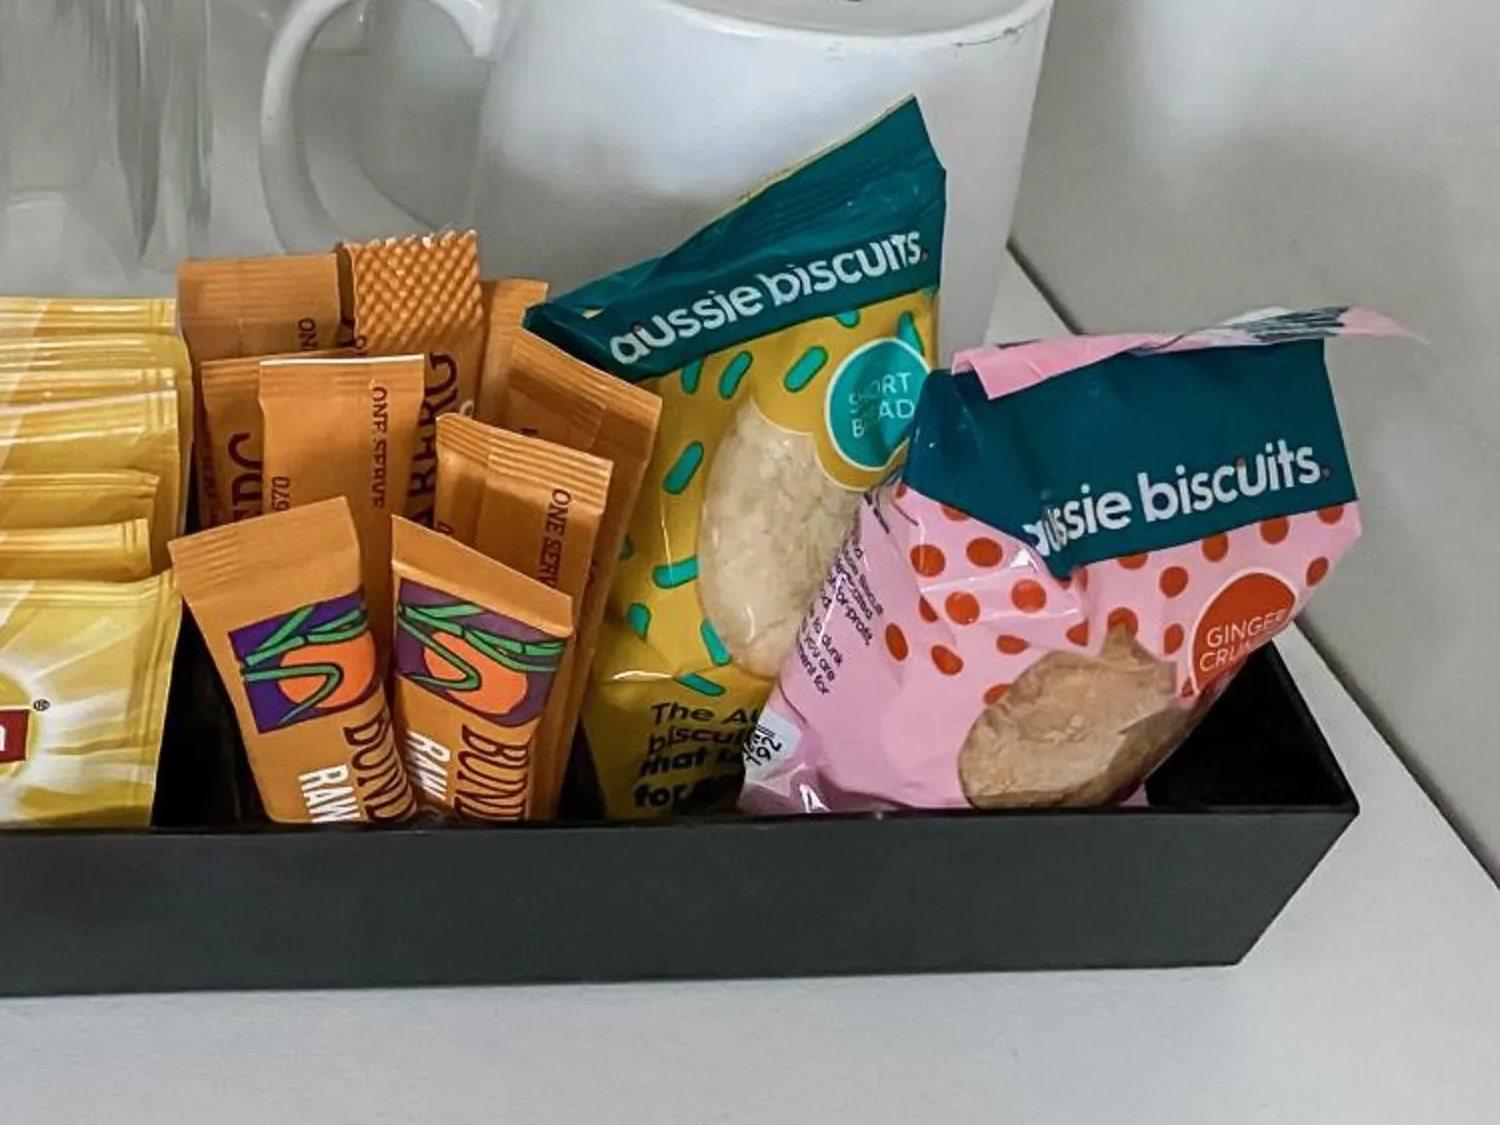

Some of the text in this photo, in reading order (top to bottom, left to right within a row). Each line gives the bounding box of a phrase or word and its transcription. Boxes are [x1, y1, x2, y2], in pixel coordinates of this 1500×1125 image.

[610, 284, 764, 364] aussie
[848, 372, 912, 414] SORT
[851, 398, 915, 438] BAD
[539, 488, 571, 588] ONE SERV
[651, 702, 715, 725] The
[297, 764, 362, 823] RAW
